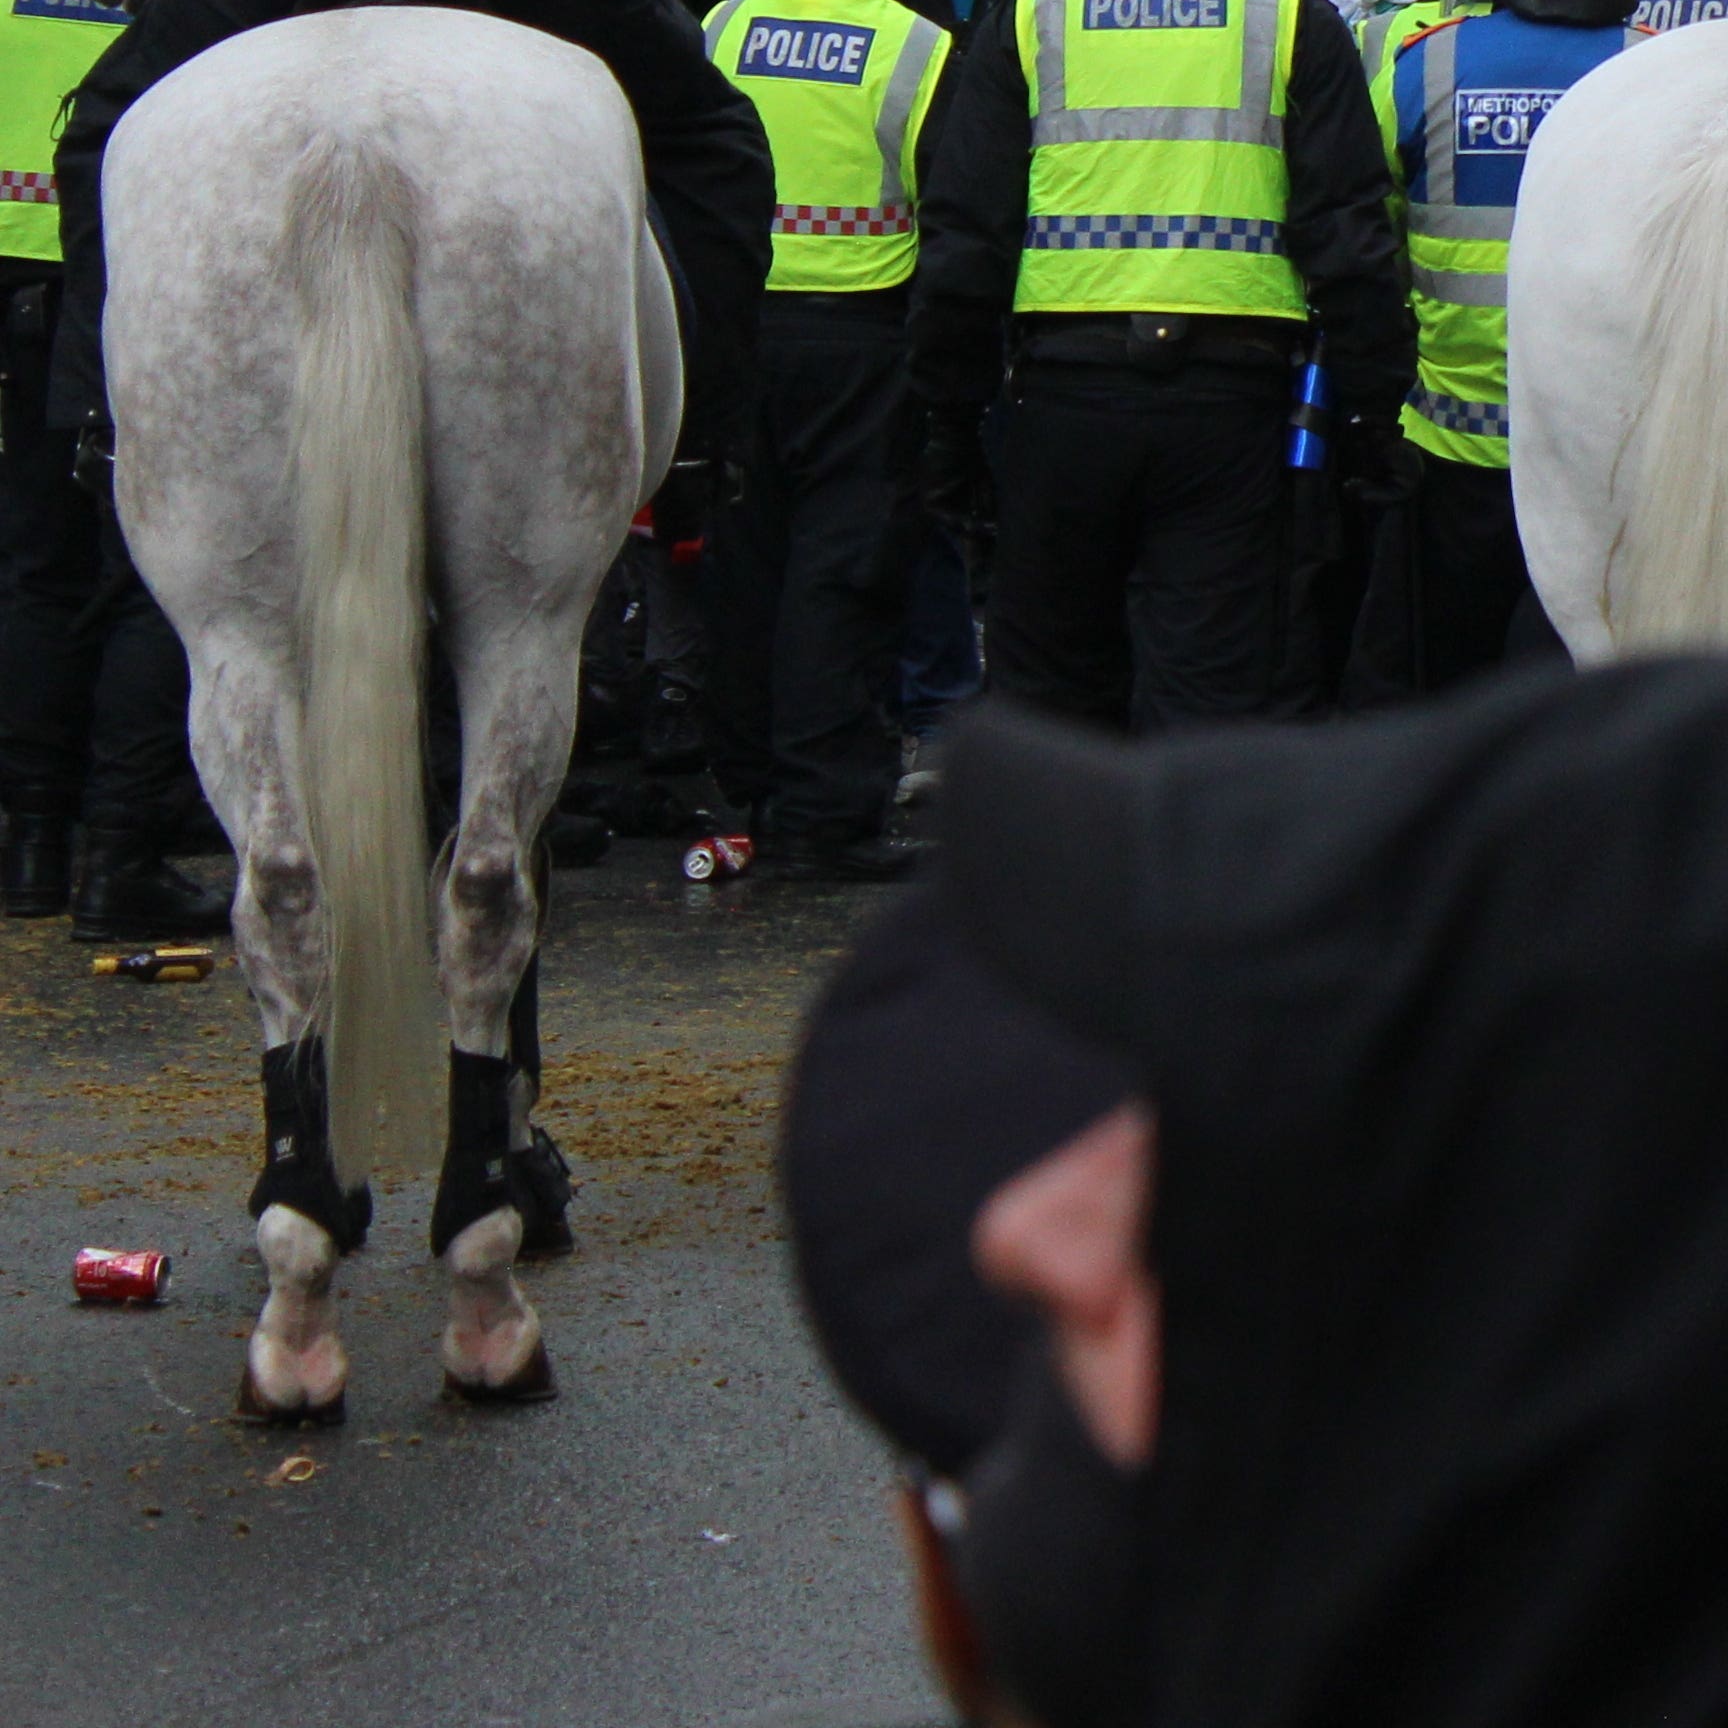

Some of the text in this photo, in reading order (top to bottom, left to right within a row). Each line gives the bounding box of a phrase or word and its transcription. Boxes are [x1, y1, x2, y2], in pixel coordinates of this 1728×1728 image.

[743, 25, 867, 75] POLICE
[1467, 97, 1555, 113] METROPO
[1467, 115, 1531, 145] POL
